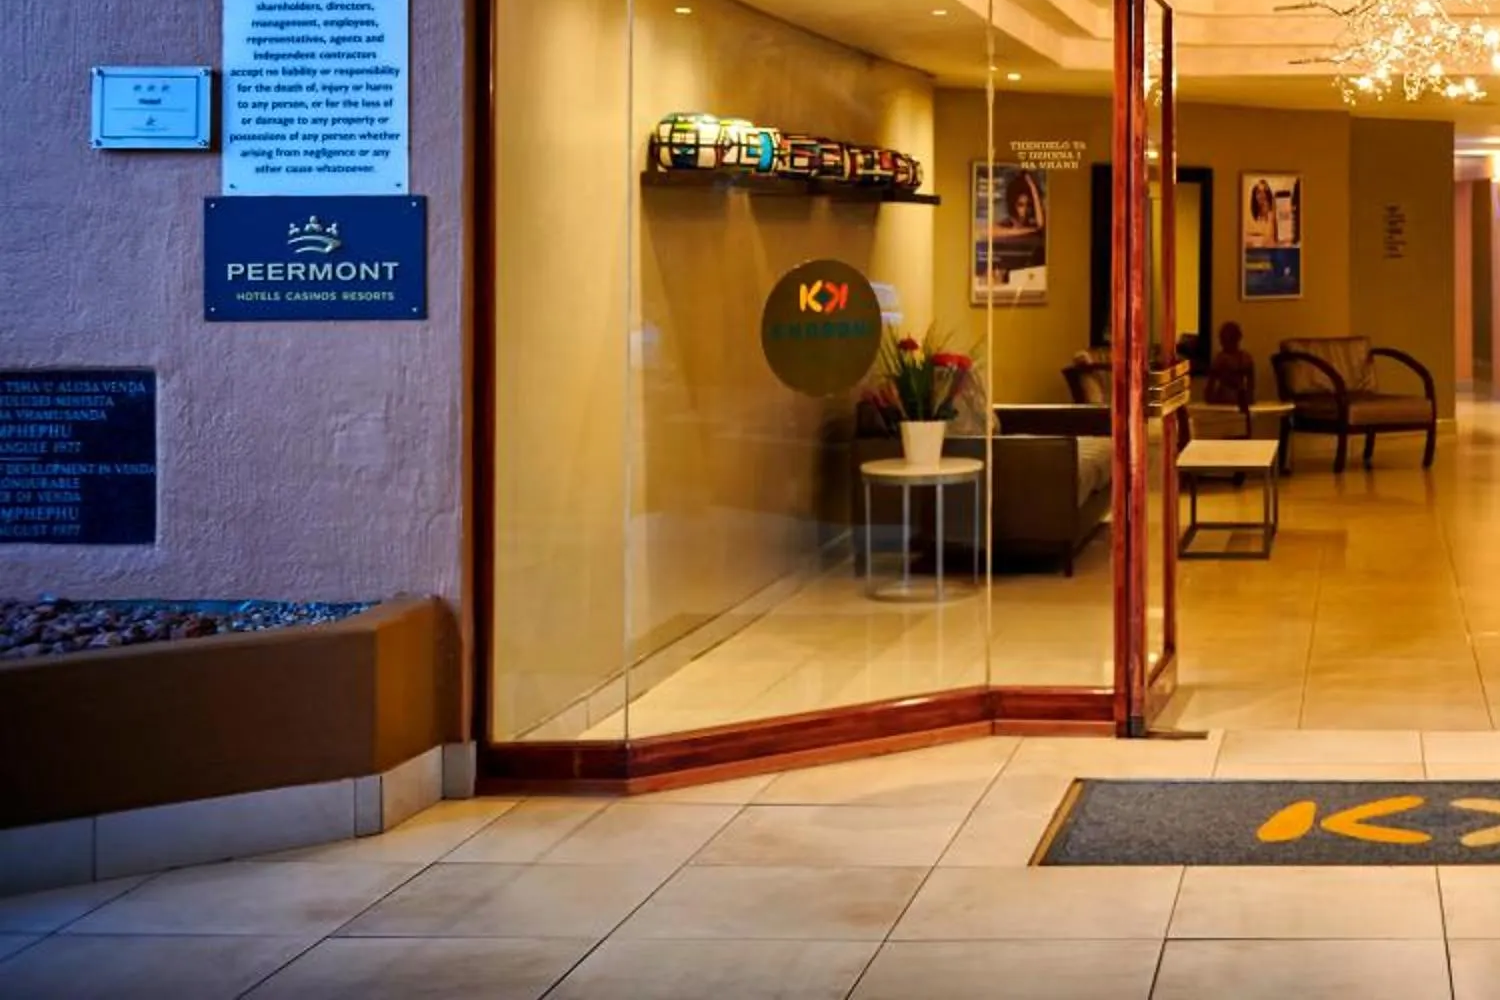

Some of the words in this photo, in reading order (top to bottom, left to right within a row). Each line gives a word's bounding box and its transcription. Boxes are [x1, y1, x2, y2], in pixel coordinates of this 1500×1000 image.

[227, 262, 399, 281] PEERMONT
[236, 292, 280, 300] HOTELS
[285, 292, 336, 300] CASINOS
[342, 292, 394, 300] RESORTS
